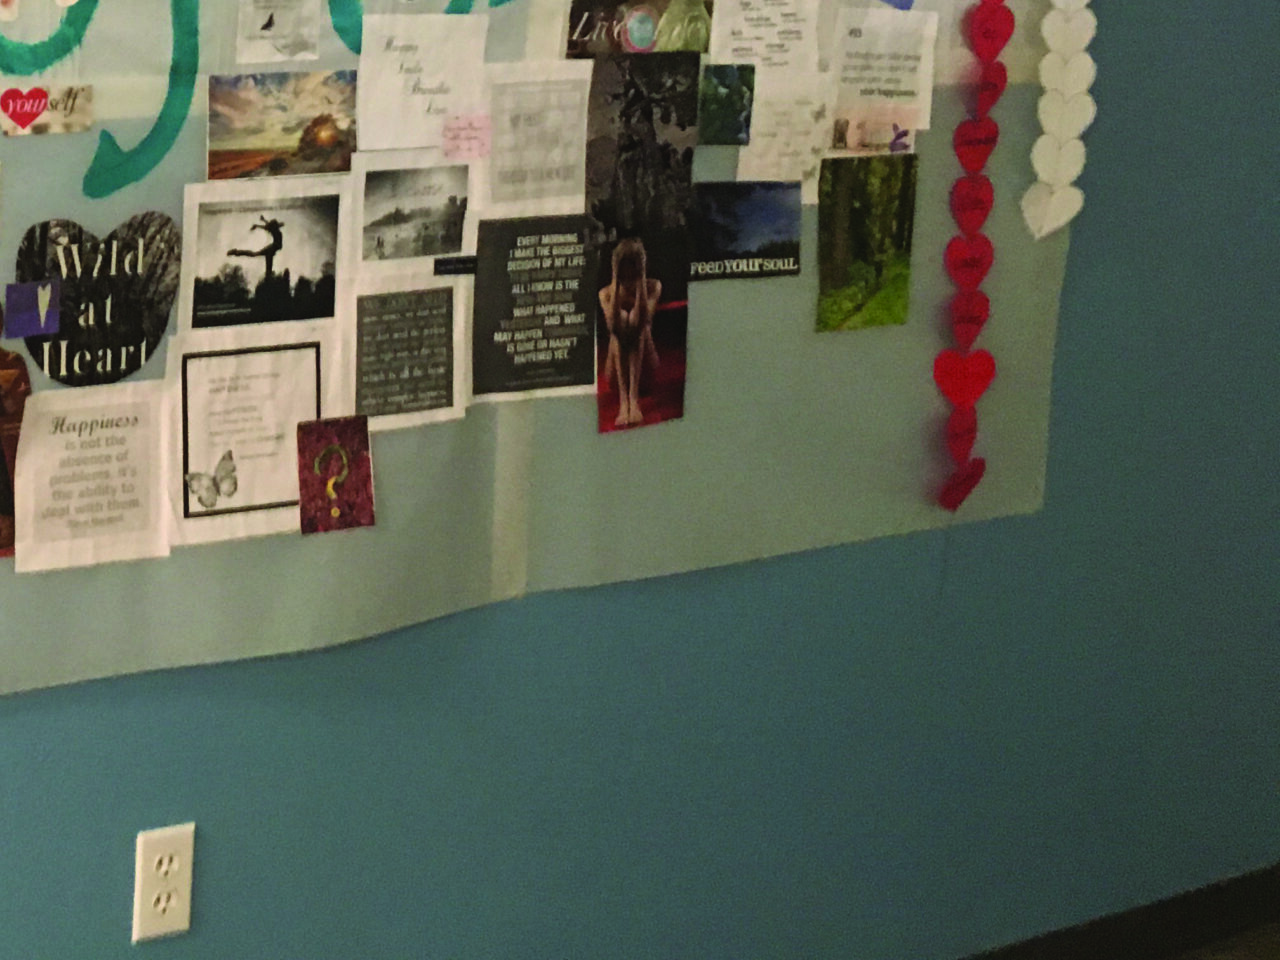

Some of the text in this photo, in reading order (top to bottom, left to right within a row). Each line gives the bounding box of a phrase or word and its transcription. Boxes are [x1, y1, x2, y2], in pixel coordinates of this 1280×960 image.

[7, 86, 80, 118] yourself
[56, 237, 144, 280] Wild
[514, 244, 585, 259] MAKE THE BIGGEST
[507, 258, 540, 271] DECISION
[542, 257, 552, 268] OF
[554, 256, 566, 267] MY
[512, 283, 526, 294] ALL
[555, 280, 563, 290] IS
[565, 279, 579, 290] THE
[78, 293, 112, 328] at
[513, 302, 575, 318] WHAT HAPPENED
[544, 315, 560, 326] AND
[493, 331, 512, 344] MAY
[514, 328, 543, 340] HAPPEN
[506, 343, 515, 354] IS
[42, 338, 147, 378] Heart
[514, 350, 552, 365] HAPPENED
[49, 416, 139, 437] Happiness
[80, 435, 127, 449] not the
